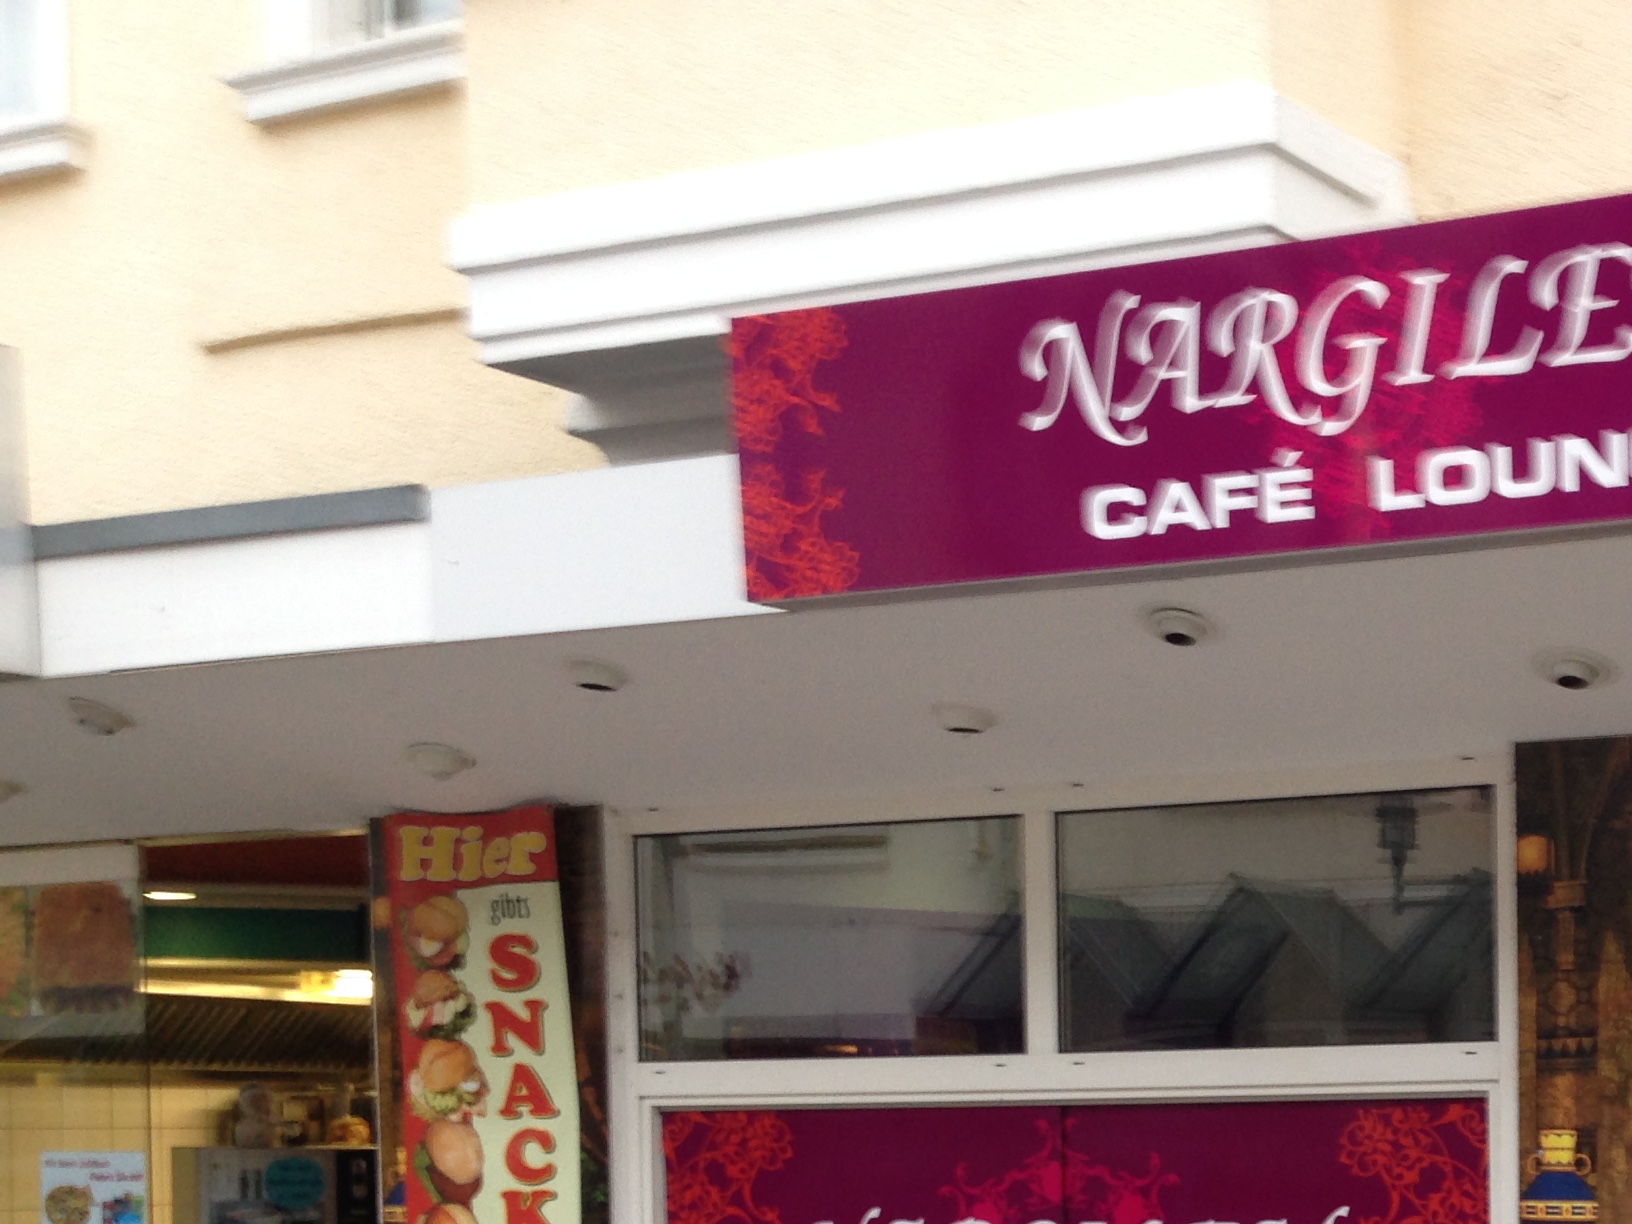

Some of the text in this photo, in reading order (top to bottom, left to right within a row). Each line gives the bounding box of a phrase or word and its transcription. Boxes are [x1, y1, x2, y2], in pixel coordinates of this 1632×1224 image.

[1083, 447, 1316, 540] CAFÉ
[399, 825, 547, 881] Hier
[490, 893, 530, 926] gibts
